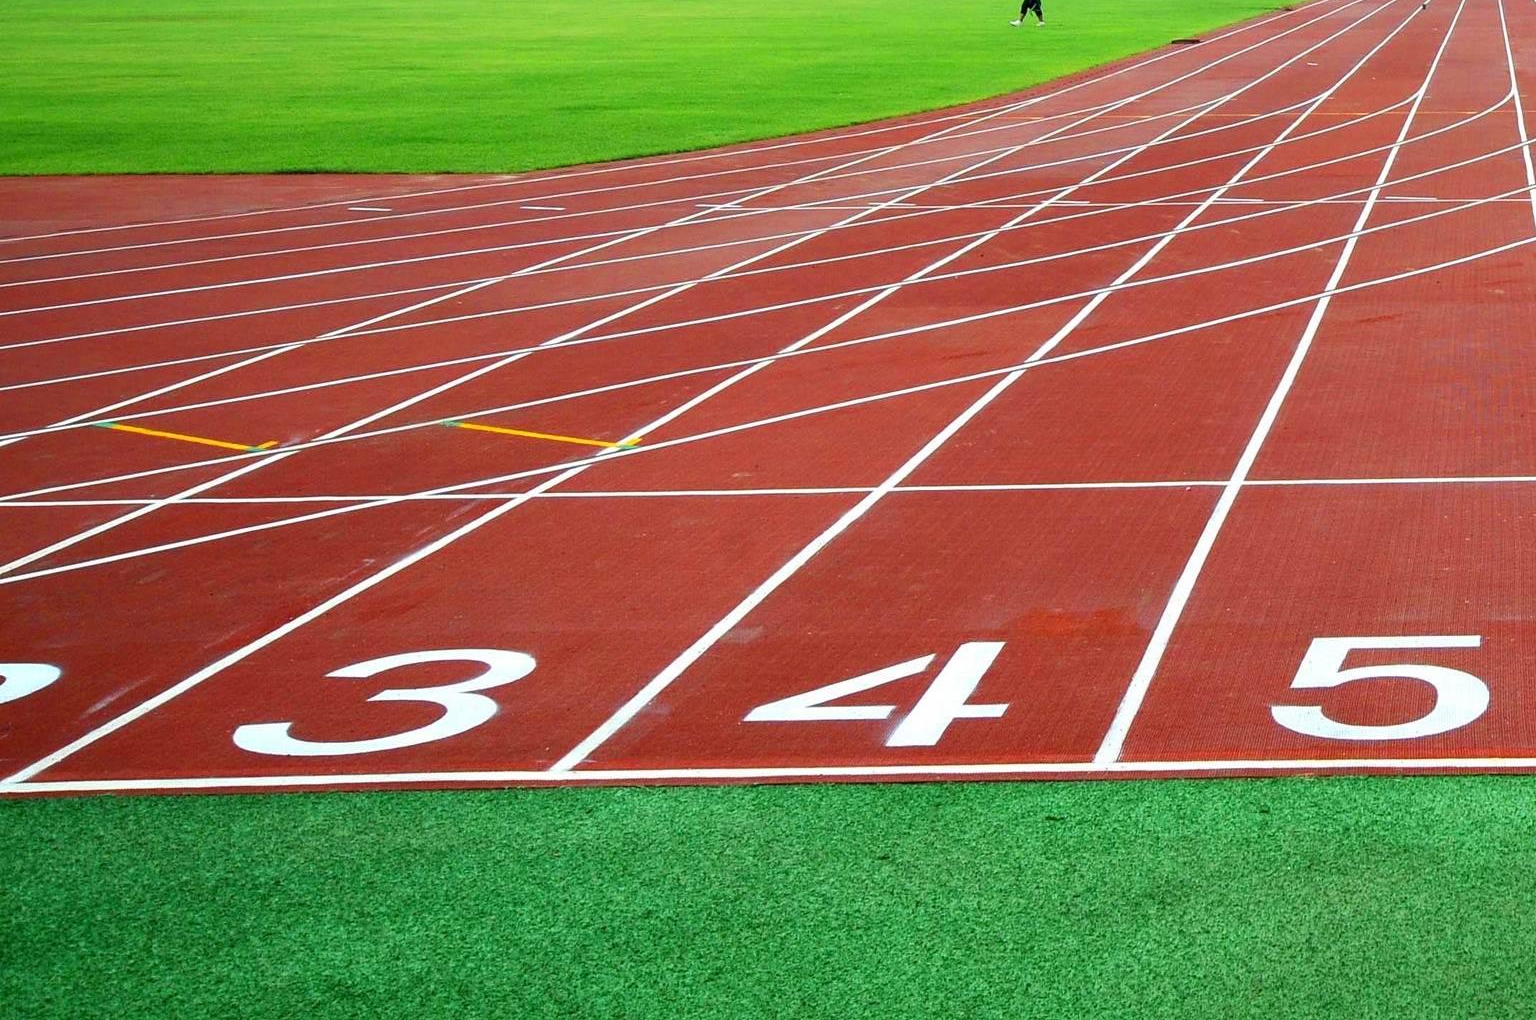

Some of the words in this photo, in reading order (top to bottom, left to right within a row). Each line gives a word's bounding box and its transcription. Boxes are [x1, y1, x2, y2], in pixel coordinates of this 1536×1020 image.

[233, 649, 536, 761] 3
[743, 642, 1009, 748] 4
[1271, 635, 1490, 741] 5
